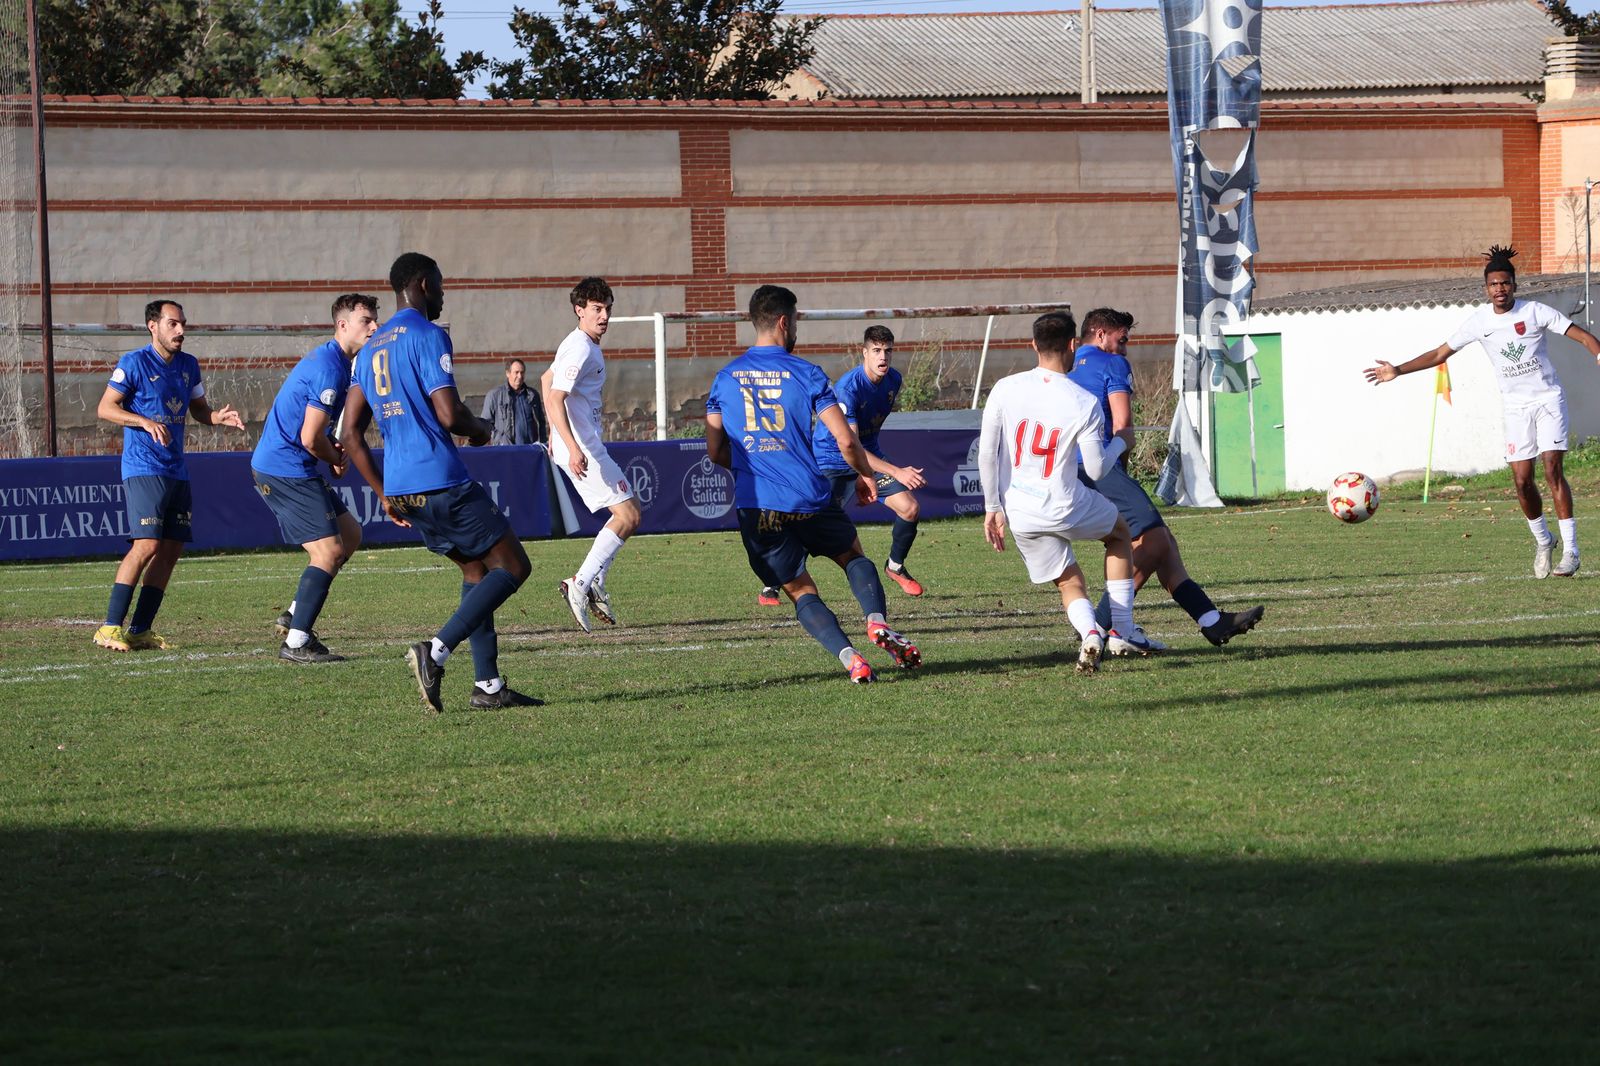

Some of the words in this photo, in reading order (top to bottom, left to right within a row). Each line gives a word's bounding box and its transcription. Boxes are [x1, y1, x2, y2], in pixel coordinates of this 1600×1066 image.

[372, 349, 392, 396] 8
[740, 387, 786, 432] 15
[1014, 418, 1063, 480] 14
[0, 484, 124, 507] YUNTAMIENT
[690, 474, 727, 488] Estrella
[692, 488, 727, 504] Galicia
[0, 510, 132, 541] ILLARAL
